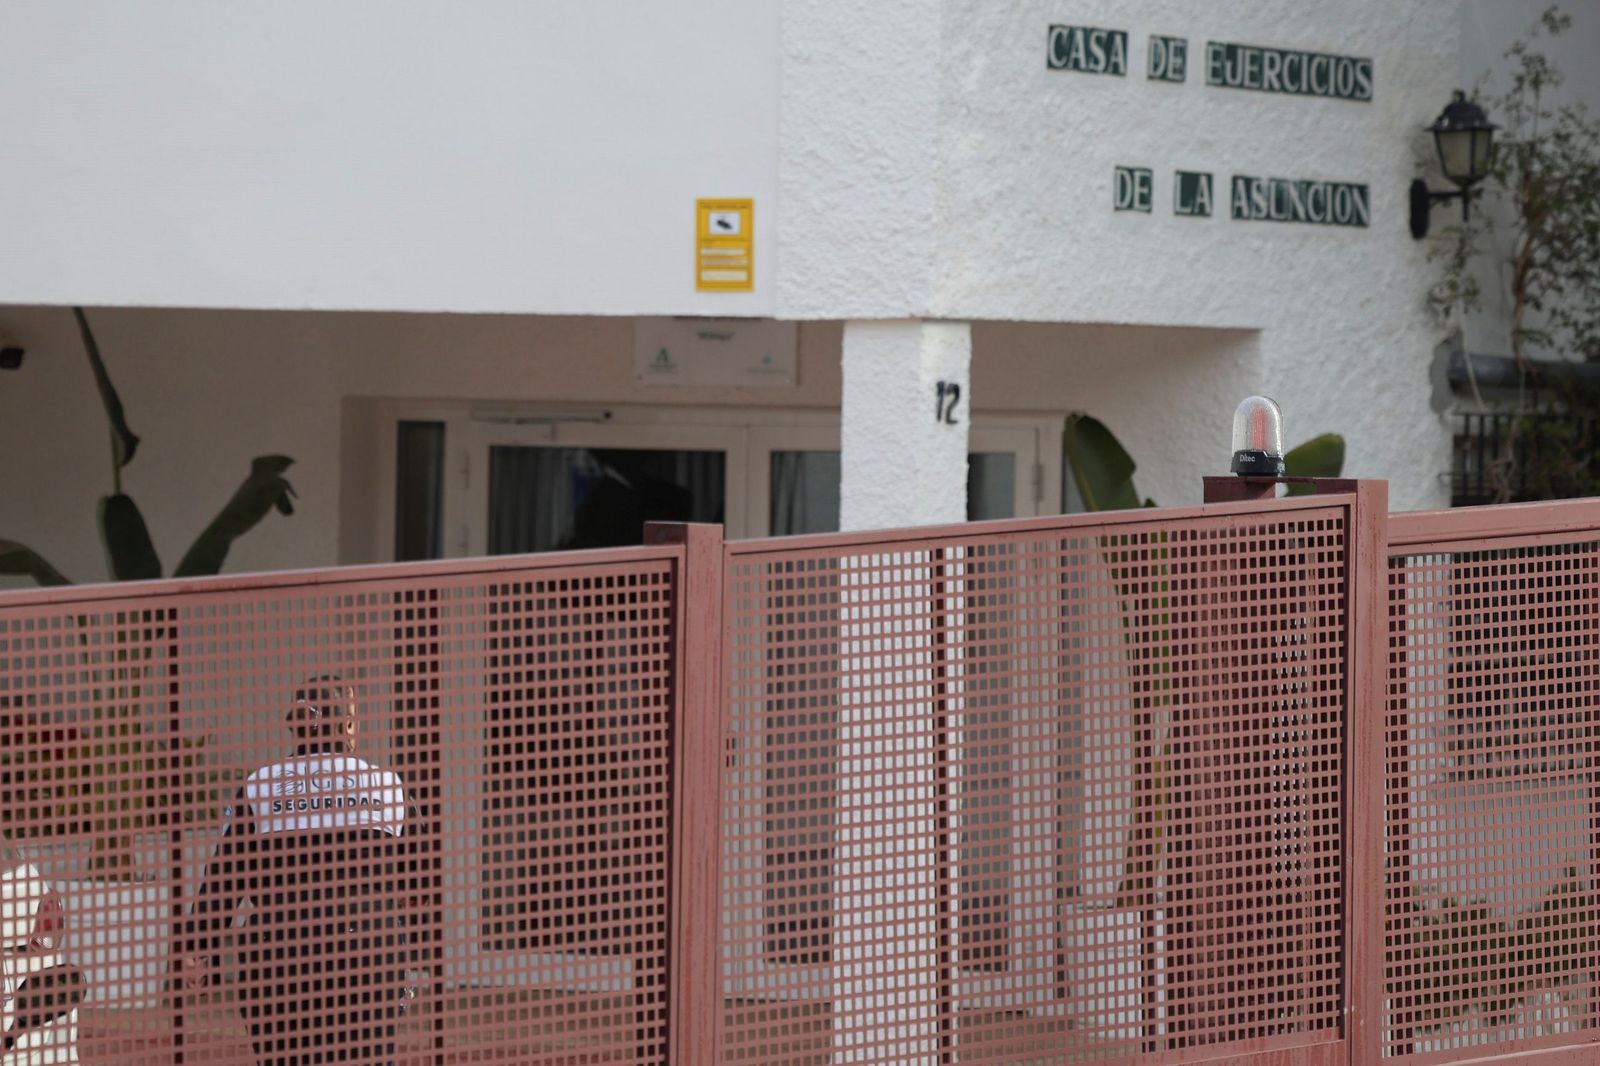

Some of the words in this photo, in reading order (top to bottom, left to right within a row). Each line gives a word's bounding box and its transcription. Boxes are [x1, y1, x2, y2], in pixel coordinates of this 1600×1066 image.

[1047, 25, 1127, 75] CASA
[1148, 36, 1186, 82] DE
[1206, 42, 1373, 101] EJERCICIOS
[1114, 166, 1151, 212] DE
[1174, 170, 1213, 216] LA
[1232, 176, 1369, 226] ASUNCION
[936, 380, 960, 425] 12
[1239, 453, 1256, 463] Ditec
[272, 796, 383, 813] SEGURIDAD
